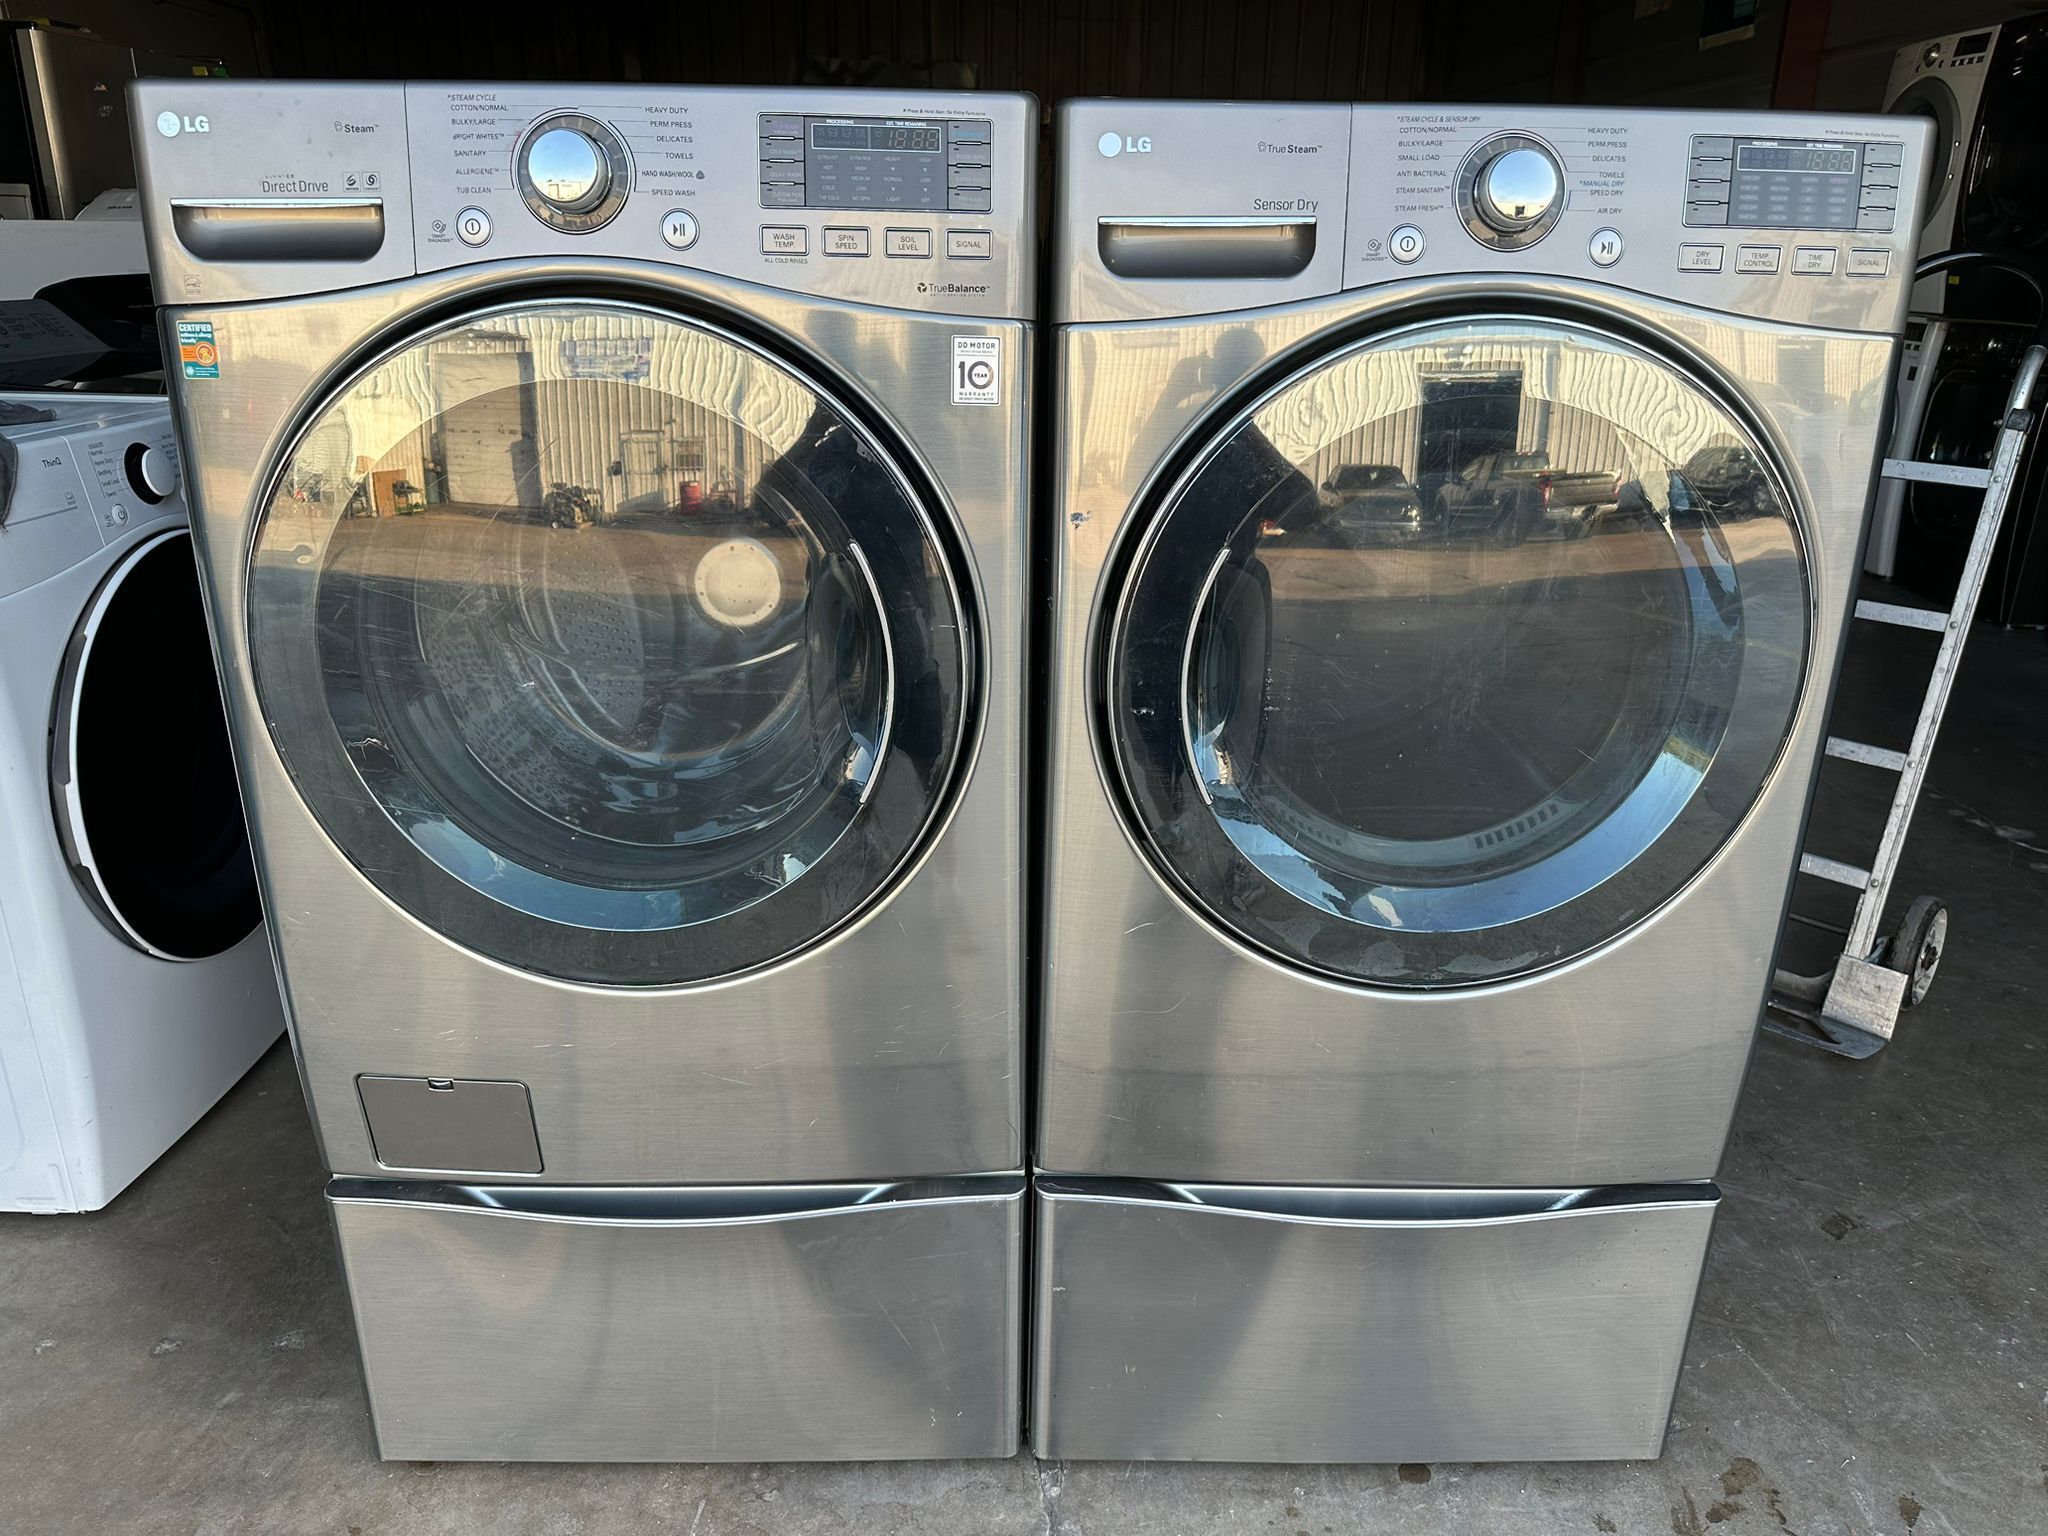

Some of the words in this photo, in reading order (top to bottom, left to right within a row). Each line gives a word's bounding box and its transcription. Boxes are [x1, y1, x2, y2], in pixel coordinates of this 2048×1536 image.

[183, 115, 210, 133] LG
[1399, 126, 1457, 134] COTTON/NORMAL
[1126, 136, 1152, 154] LG
[659, 170, 694, 178] WASH/WOOL
[262, 180, 298, 193] Direct
[299, 180, 329, 192] Drive
[1254, 198, 1294, 211] Sensor
[1296, 198, 1319, 213] Dry
[772, 232, 795, 240] WASH
[838, 234, 855, 242] SPIN
[900, 235, 916, 243] SOIL
[835, 242, 858, 250] SPEED
[898, 242, 919, 252] LEVEL
[956, 240, 982, 249] SIGNAL
[1692, 258, 1712, 266] LEVEL
[1743, 260, 1774, 268] CONTROL
[1808, 261, 1821, 269] DRY
[1856, 259, 1880, 268] SIGNAL
[178, 323, 212, 332] CERTIFIED
[958, 360, 994, 390] 10
[41, 456, 62, 468] ThinQ
